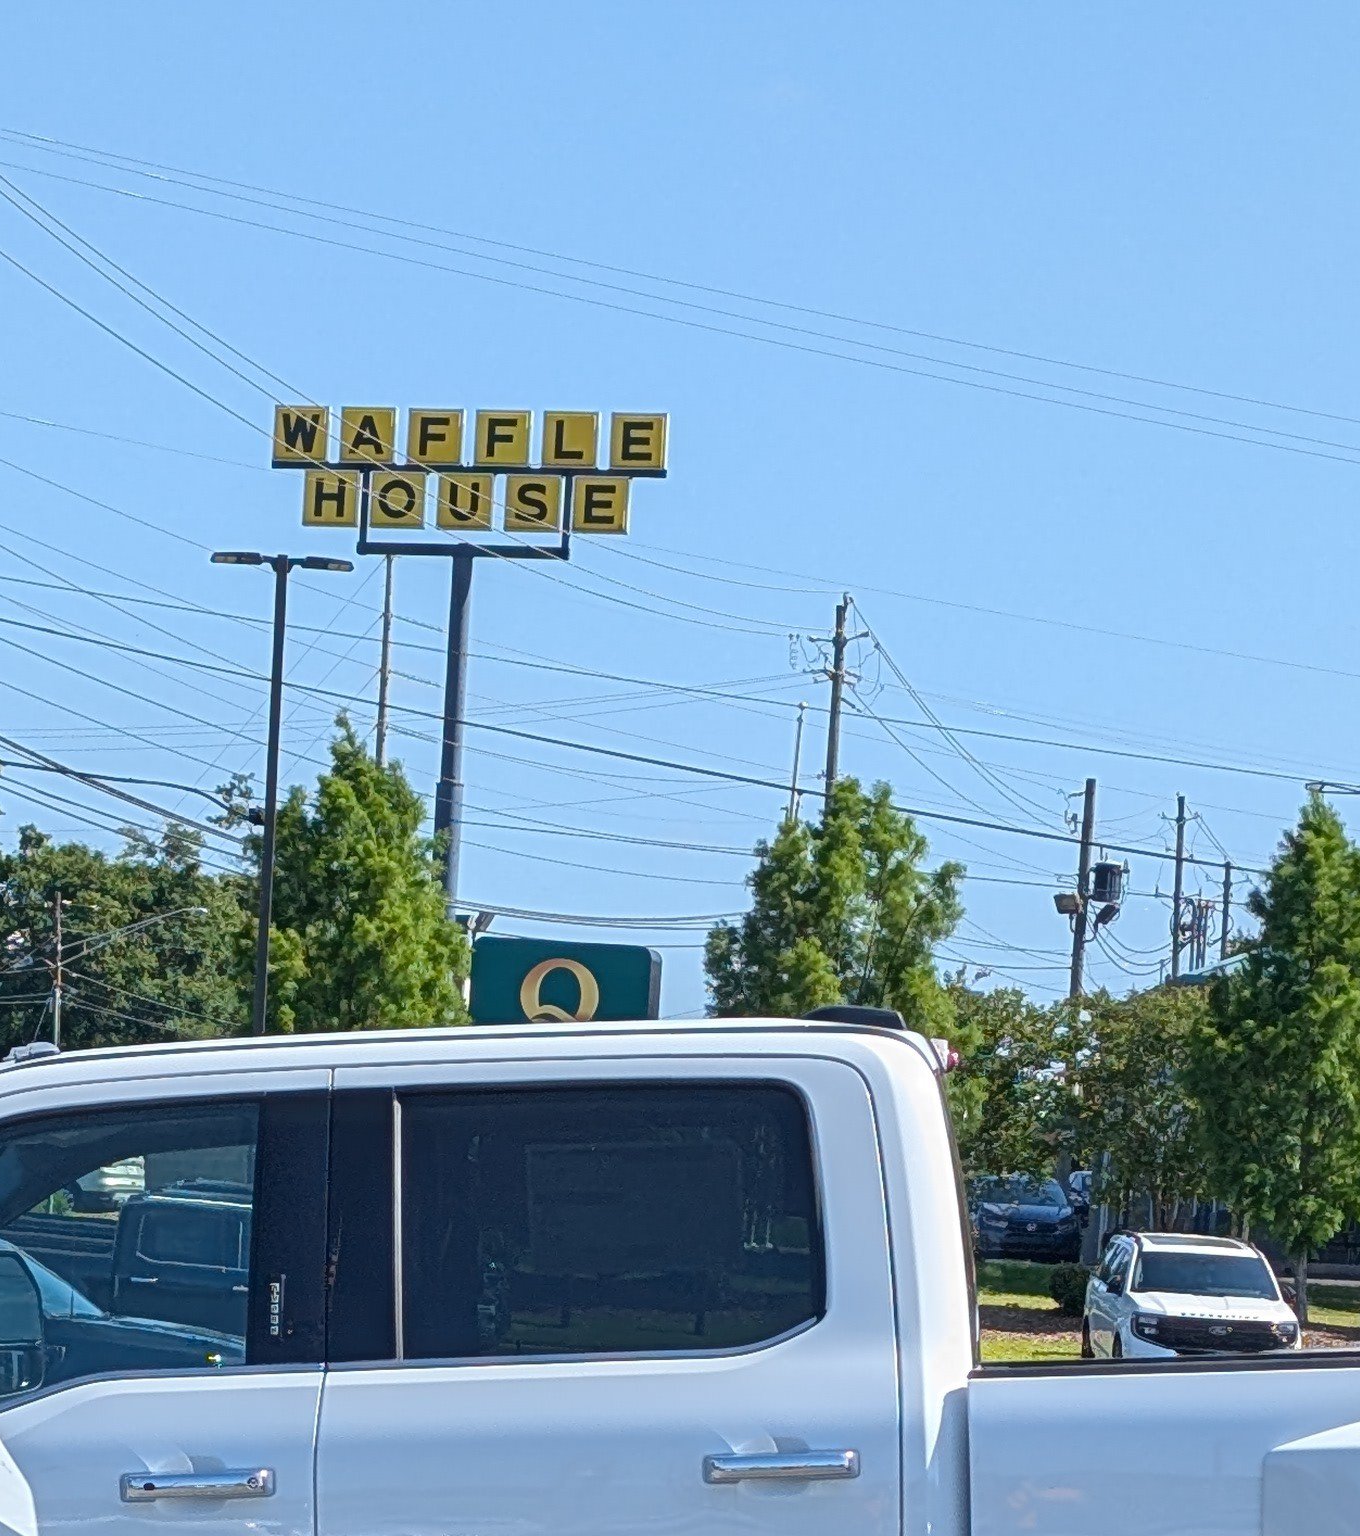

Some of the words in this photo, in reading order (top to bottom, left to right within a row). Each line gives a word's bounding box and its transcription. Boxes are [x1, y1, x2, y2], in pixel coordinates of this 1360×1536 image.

[281, 412, 654, 461] WAFFLE
[313, 477, 617, 526] HOUSE
[520, 957, 600, 1023] Q
